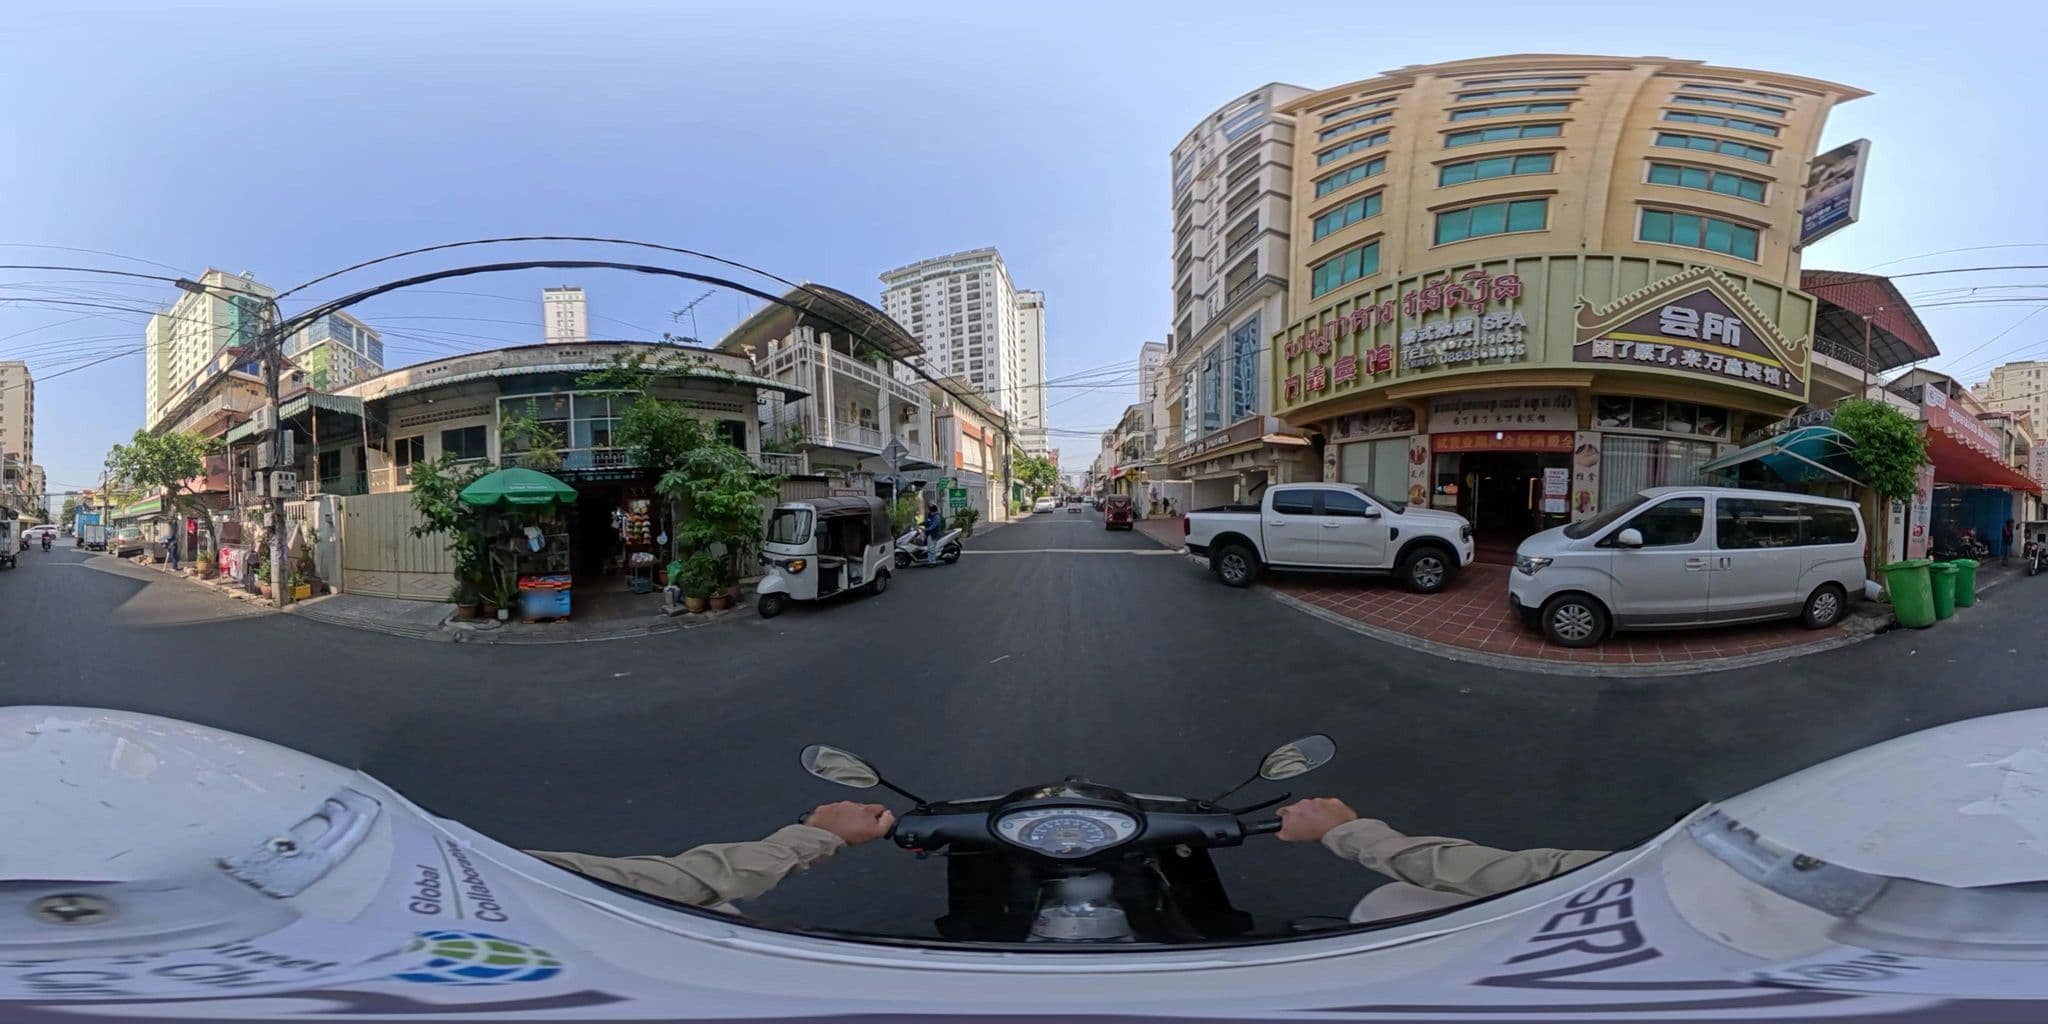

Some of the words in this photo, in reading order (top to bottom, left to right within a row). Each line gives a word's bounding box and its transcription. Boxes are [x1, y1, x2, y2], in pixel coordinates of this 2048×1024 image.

[1480, 311, 1528, 331] SPA
[1658, 304, 1743, 348] 会所
[408, 863, 442, 915] Global
